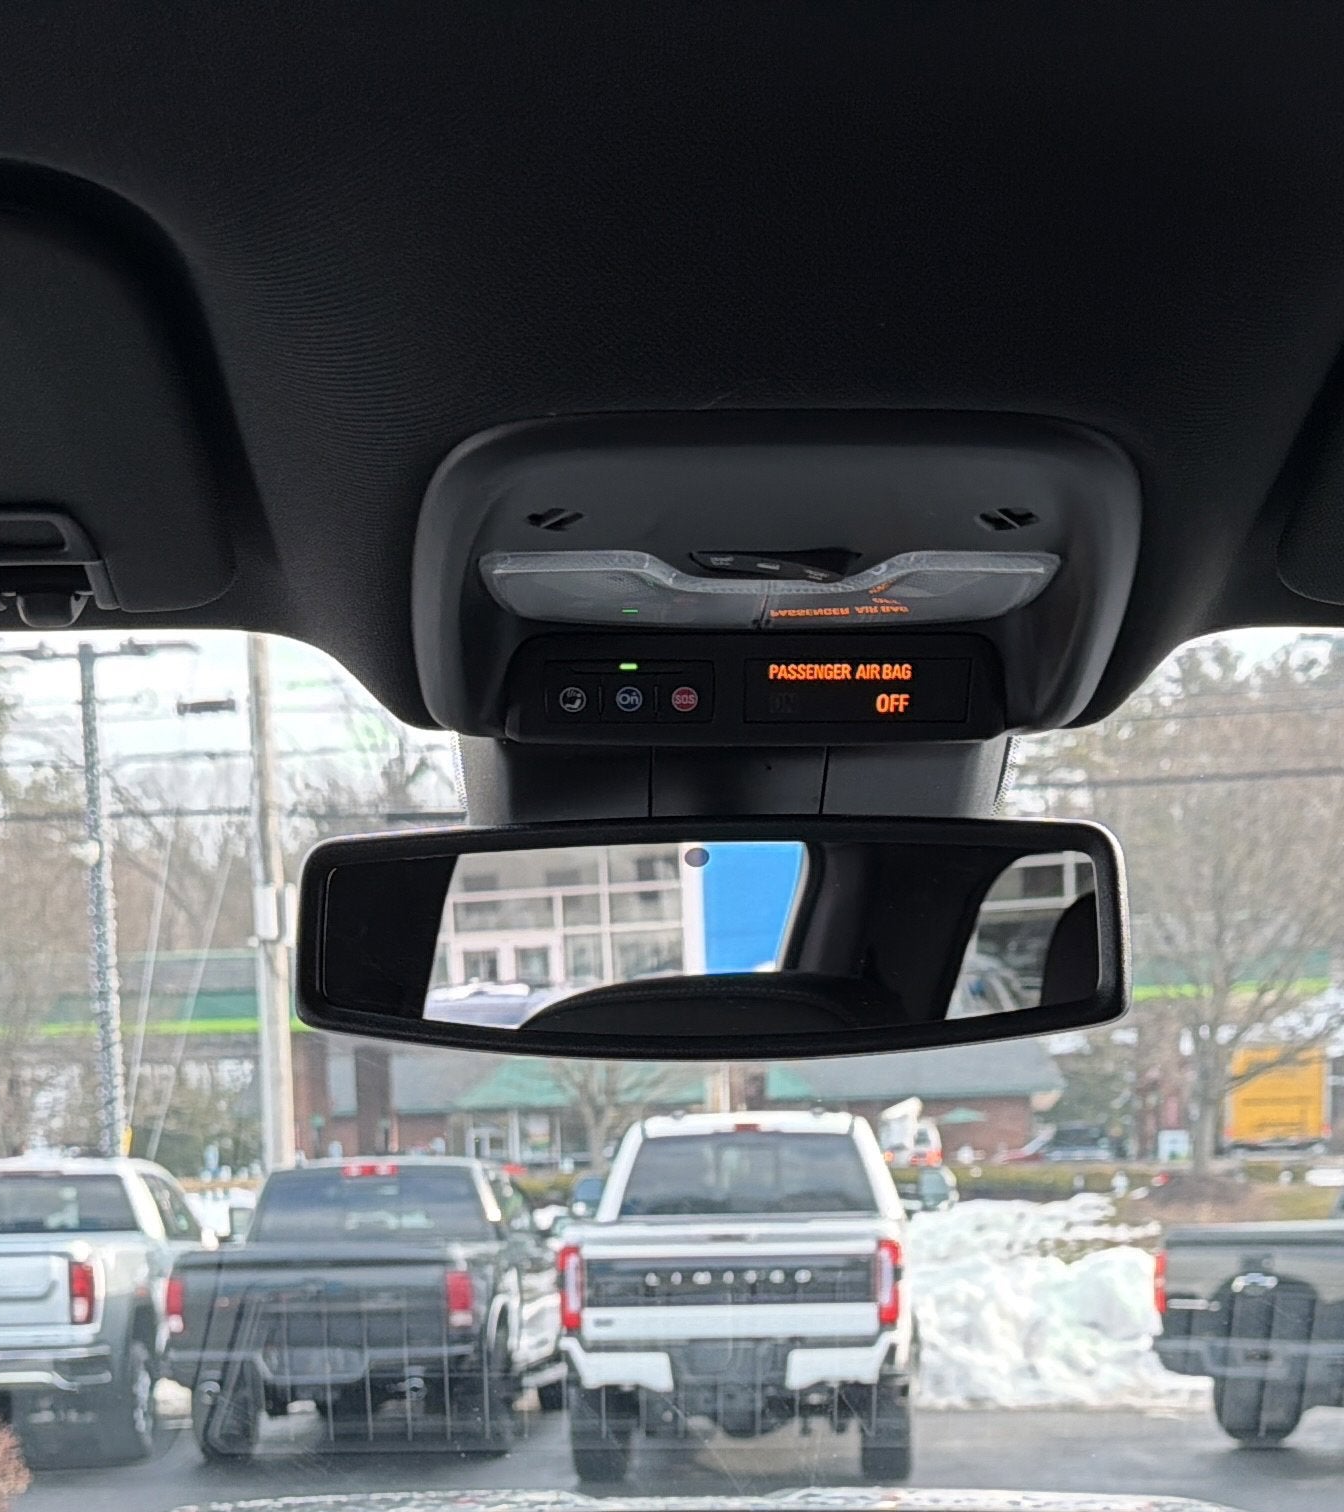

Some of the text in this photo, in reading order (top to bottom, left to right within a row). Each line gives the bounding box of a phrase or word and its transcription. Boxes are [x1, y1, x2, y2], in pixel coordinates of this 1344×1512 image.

[768, 663, 912, 681] PASSENGER AIR BAG
[674, 693, 695, 705] SOS
[876, 693, 911, 713] OFF
